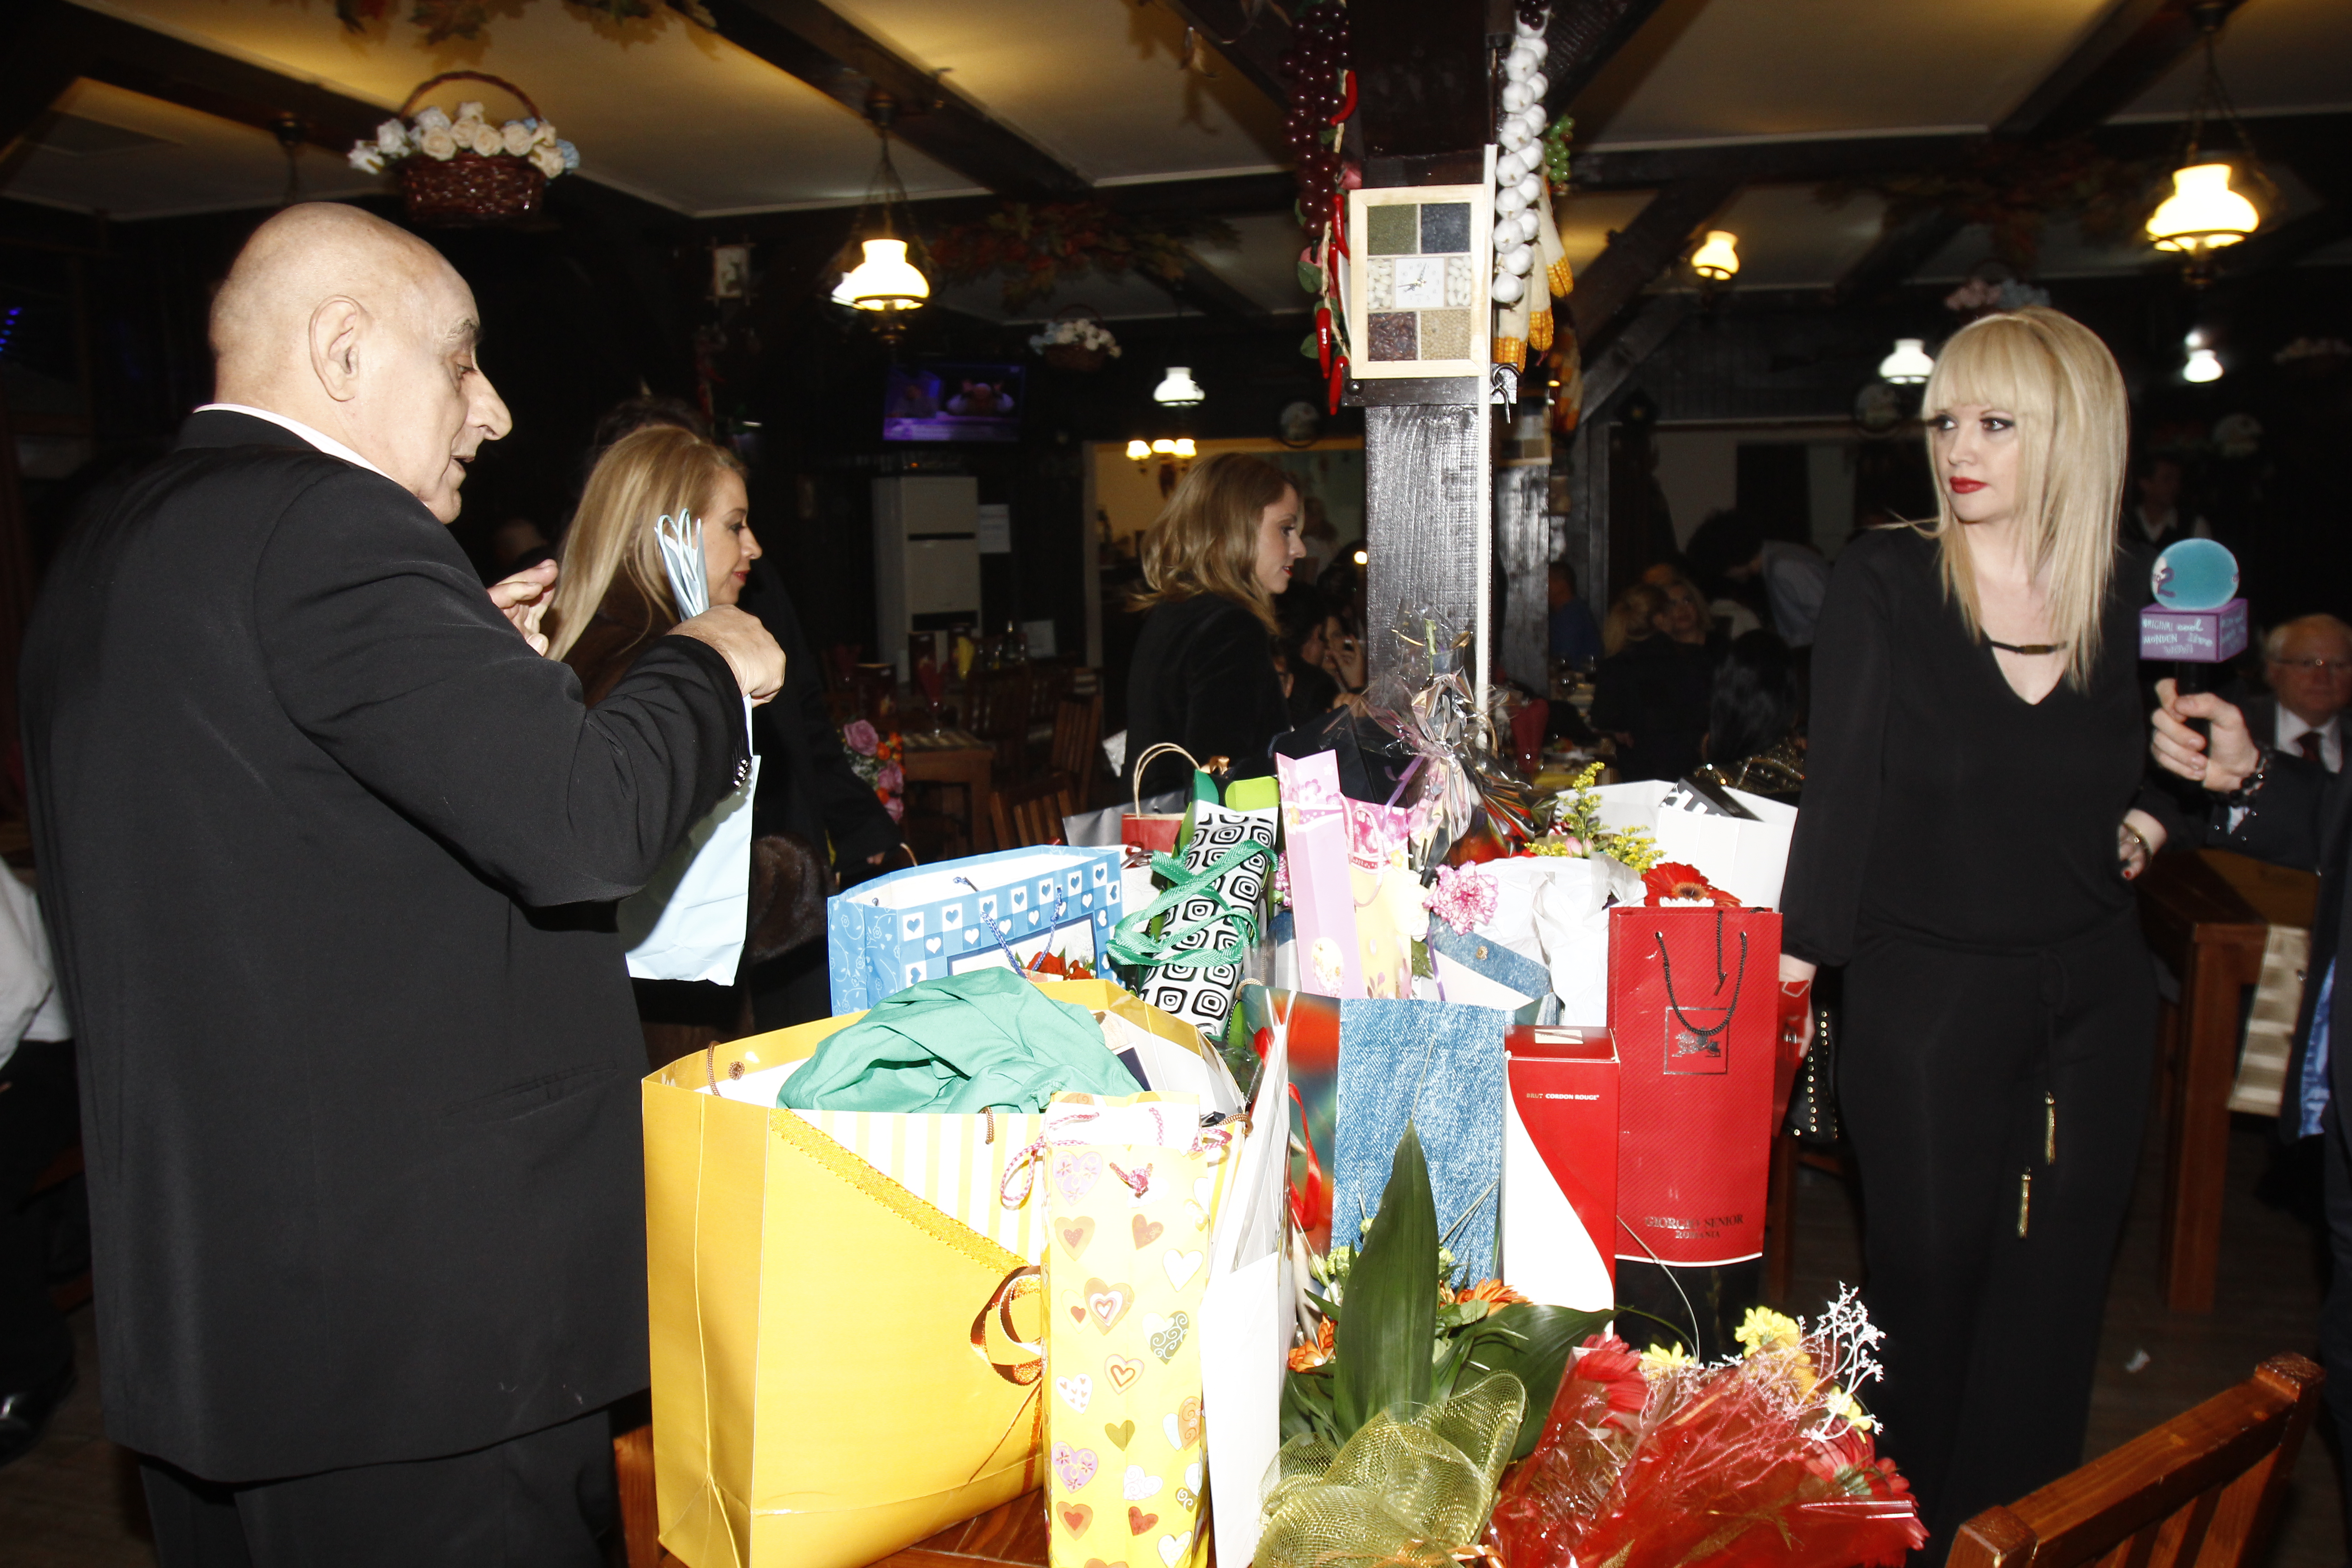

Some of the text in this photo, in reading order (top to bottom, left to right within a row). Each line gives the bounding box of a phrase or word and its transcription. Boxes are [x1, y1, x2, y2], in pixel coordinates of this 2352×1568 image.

[1645, 1214, 1744, 1230] GIORGIO SENIOR
[1675, 1230, 1720, 1239] ROMANIA
